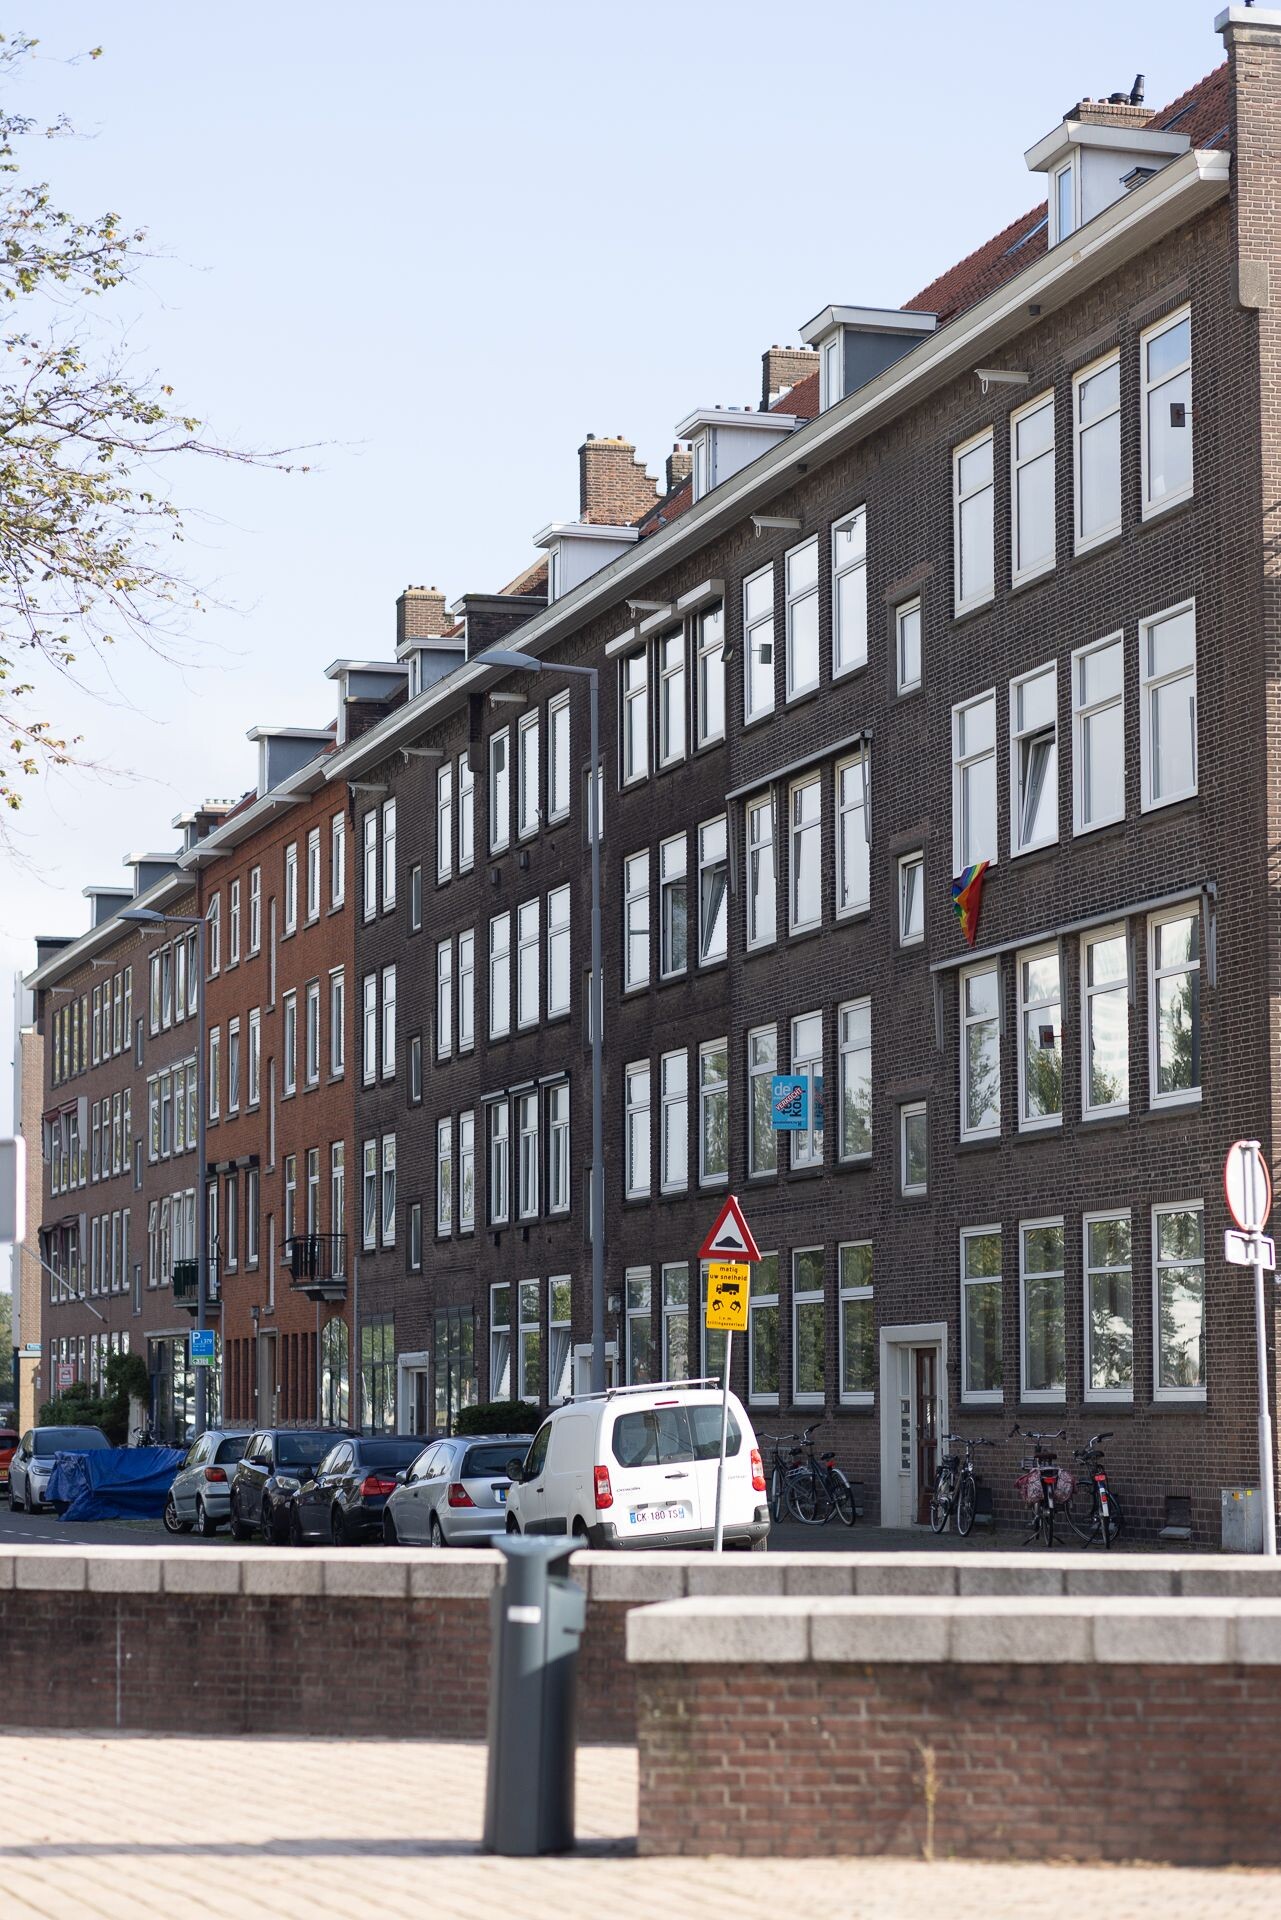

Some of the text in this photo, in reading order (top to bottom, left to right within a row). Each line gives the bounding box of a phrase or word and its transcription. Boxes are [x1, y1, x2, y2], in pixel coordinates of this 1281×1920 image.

[775, 1087, 803, 1111] VERKOCHT
[719, 1266, 738, 1274] matig
[192, 1332, 201, 1344] P
